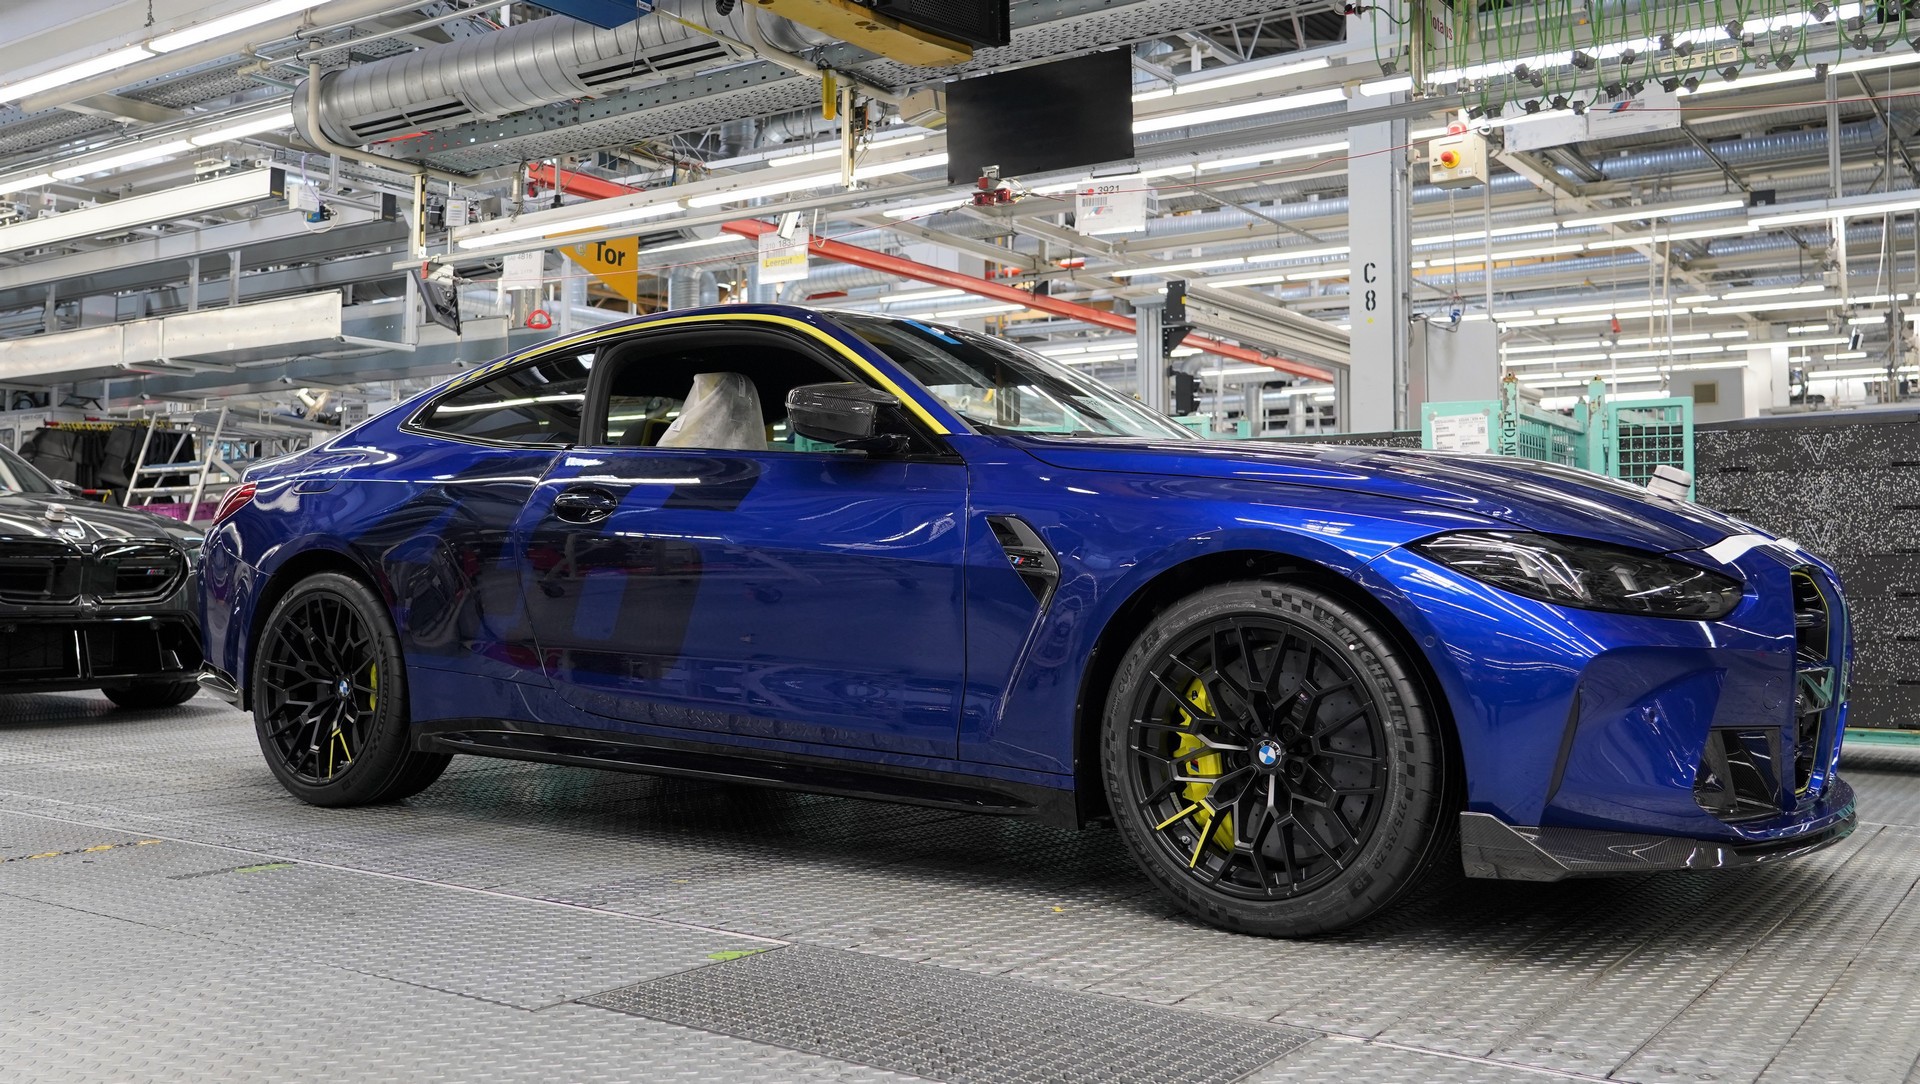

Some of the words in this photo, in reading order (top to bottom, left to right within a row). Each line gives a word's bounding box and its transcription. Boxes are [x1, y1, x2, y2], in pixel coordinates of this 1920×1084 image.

[1098, 185, 1120, 194] 3921
[595, 241, 626, 267] Tor
[1336, 626, 1408, 731] MICHELIN
